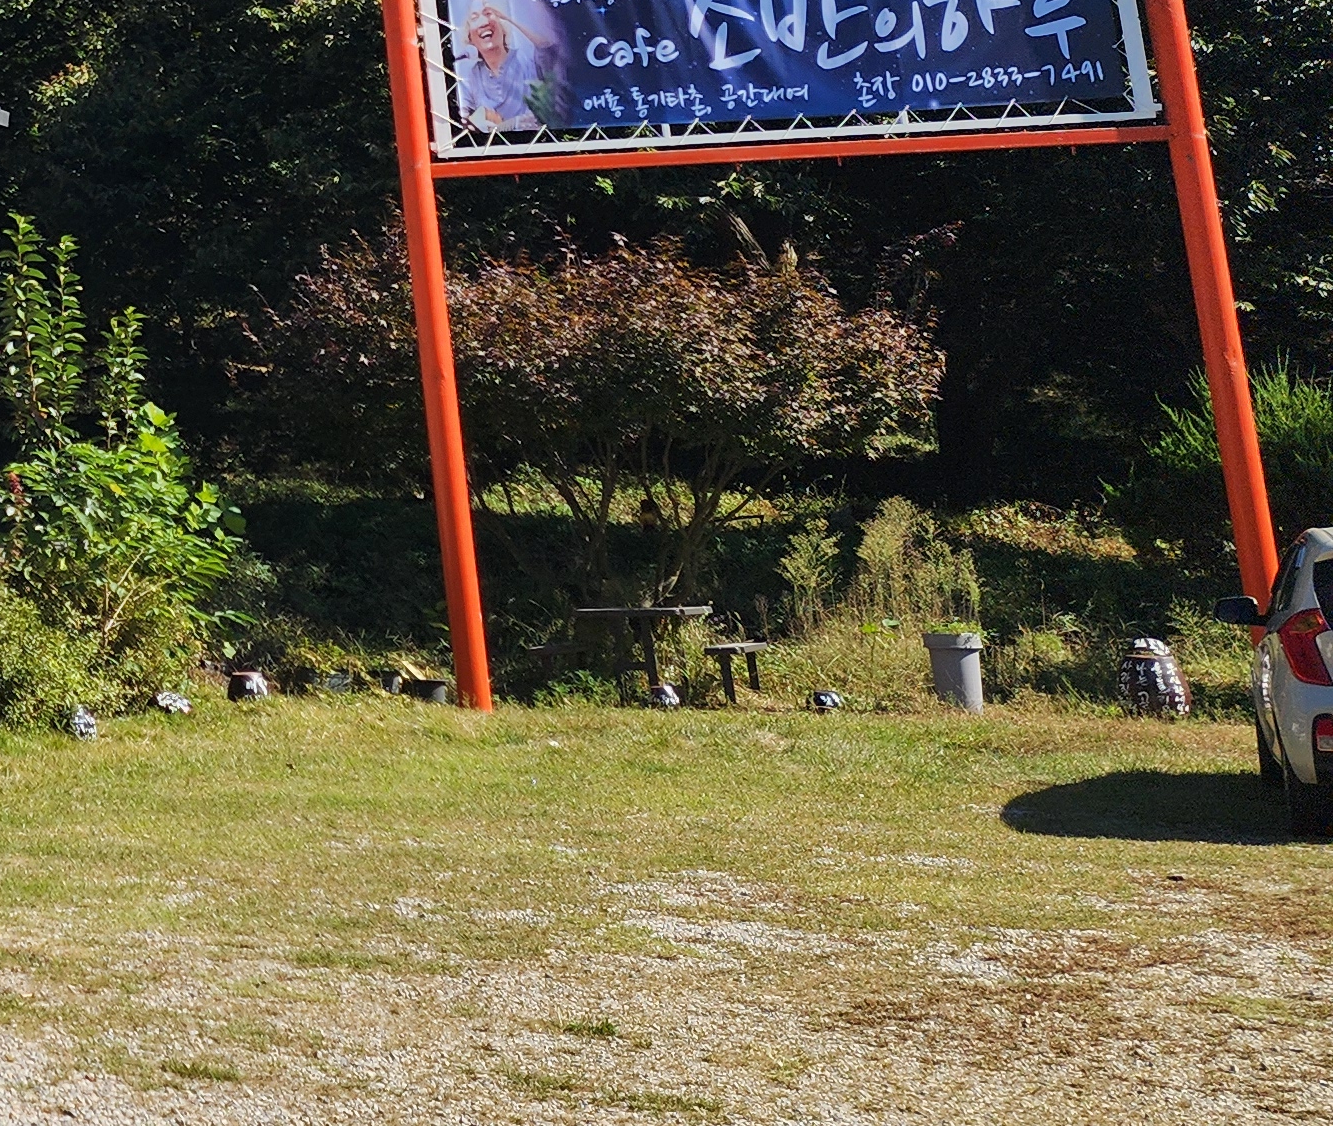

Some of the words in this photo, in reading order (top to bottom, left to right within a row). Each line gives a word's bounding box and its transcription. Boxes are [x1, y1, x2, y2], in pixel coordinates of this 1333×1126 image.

[719, 82, 810, 110] 공간대여
[853, 70, 900, 108] 촌장
[911, 60, 1105, 93] 010-2833-7491
